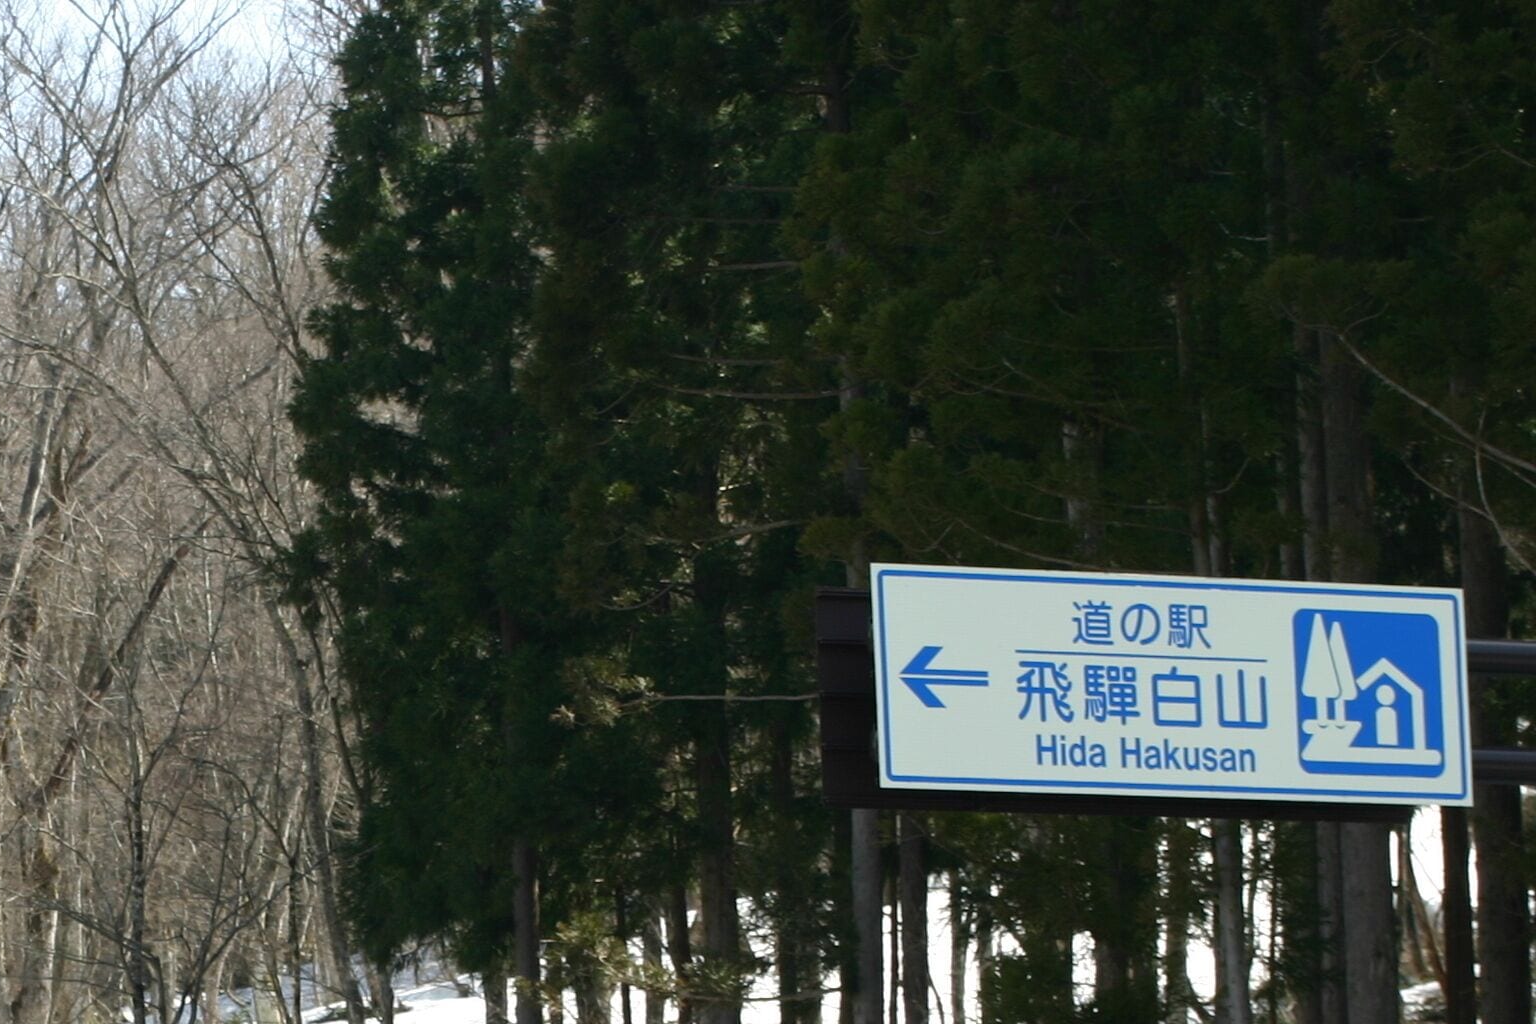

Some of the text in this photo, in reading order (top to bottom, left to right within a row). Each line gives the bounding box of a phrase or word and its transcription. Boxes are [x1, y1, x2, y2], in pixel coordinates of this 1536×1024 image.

[1072, 600, 1212, 649] 道の駅
[1035, 733, 1257, 773] Hida Hakusan
